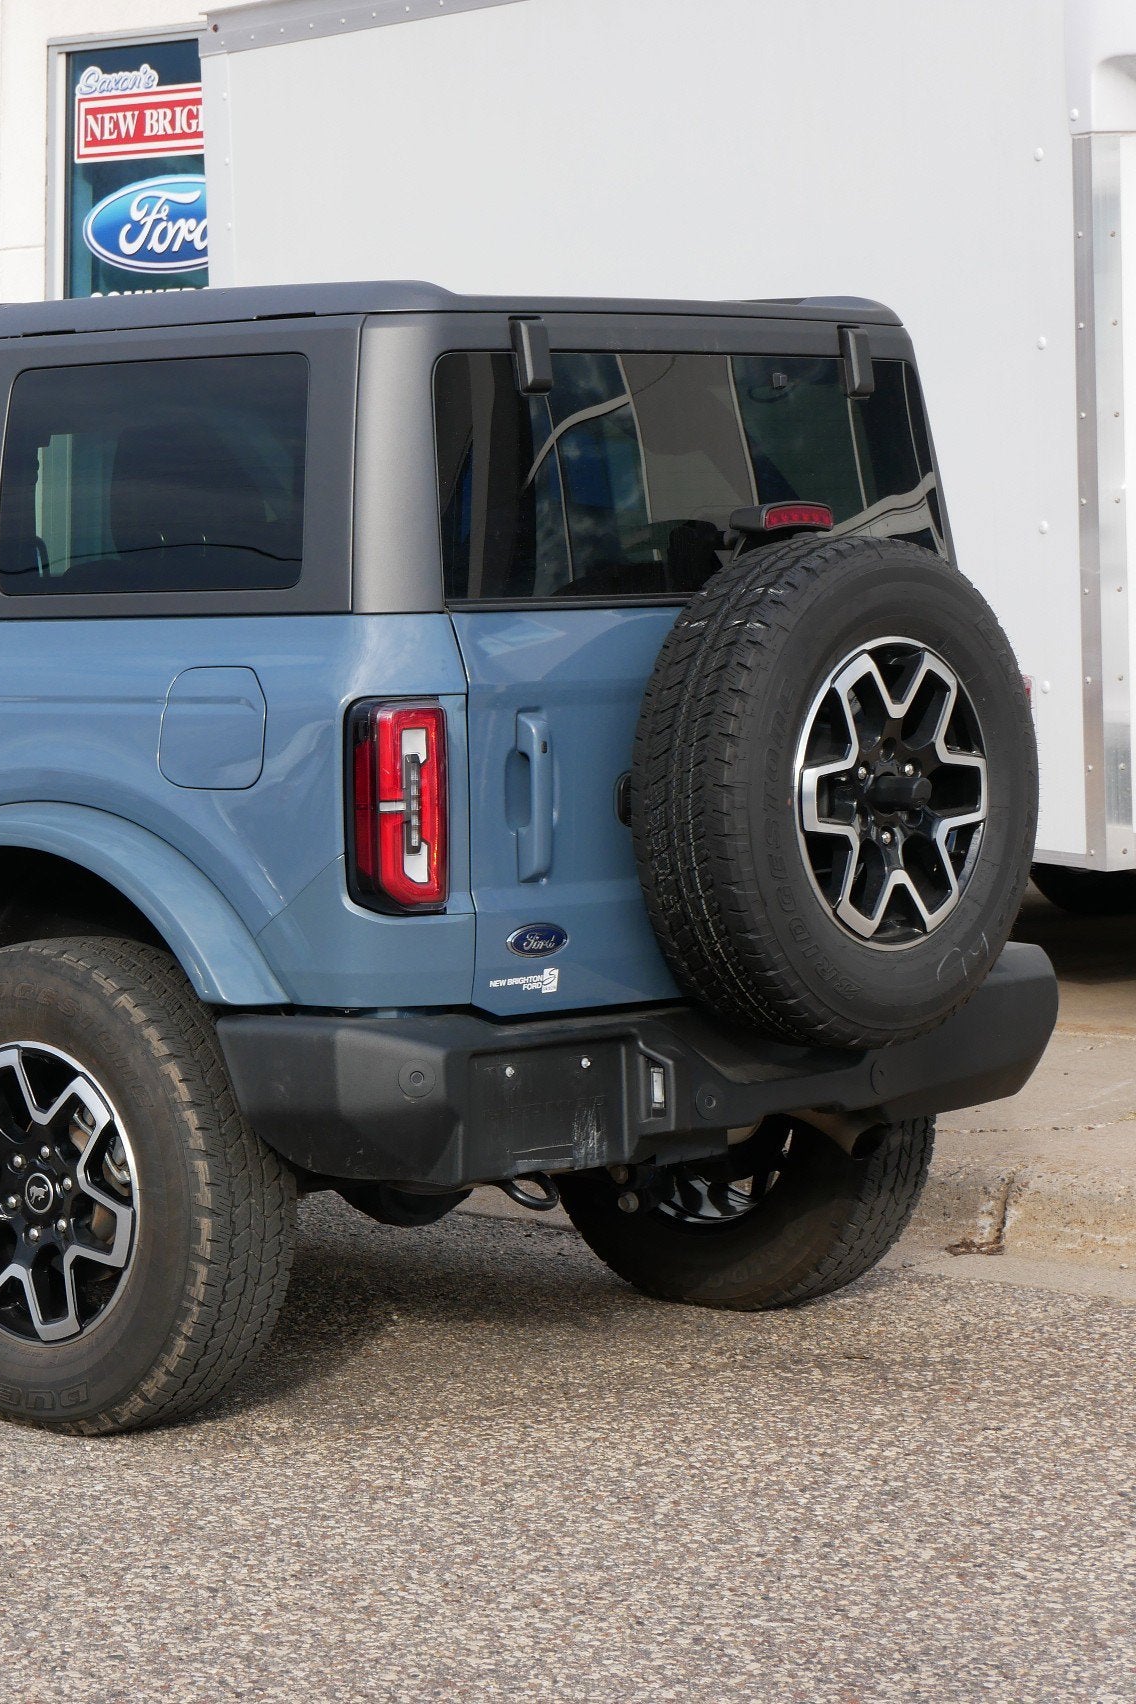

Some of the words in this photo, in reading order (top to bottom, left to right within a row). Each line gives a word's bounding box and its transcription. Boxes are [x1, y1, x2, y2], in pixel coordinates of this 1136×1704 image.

[77, 64, 157, 96] Saxon's
[85, 111, 140, 142] NEW
[523, 932, 555, 950] Ford
[489, 979, 507, 988] NEW
[507, 975, 544, 986] BRIGHTON
[523, 982, 542, 990] FORD
